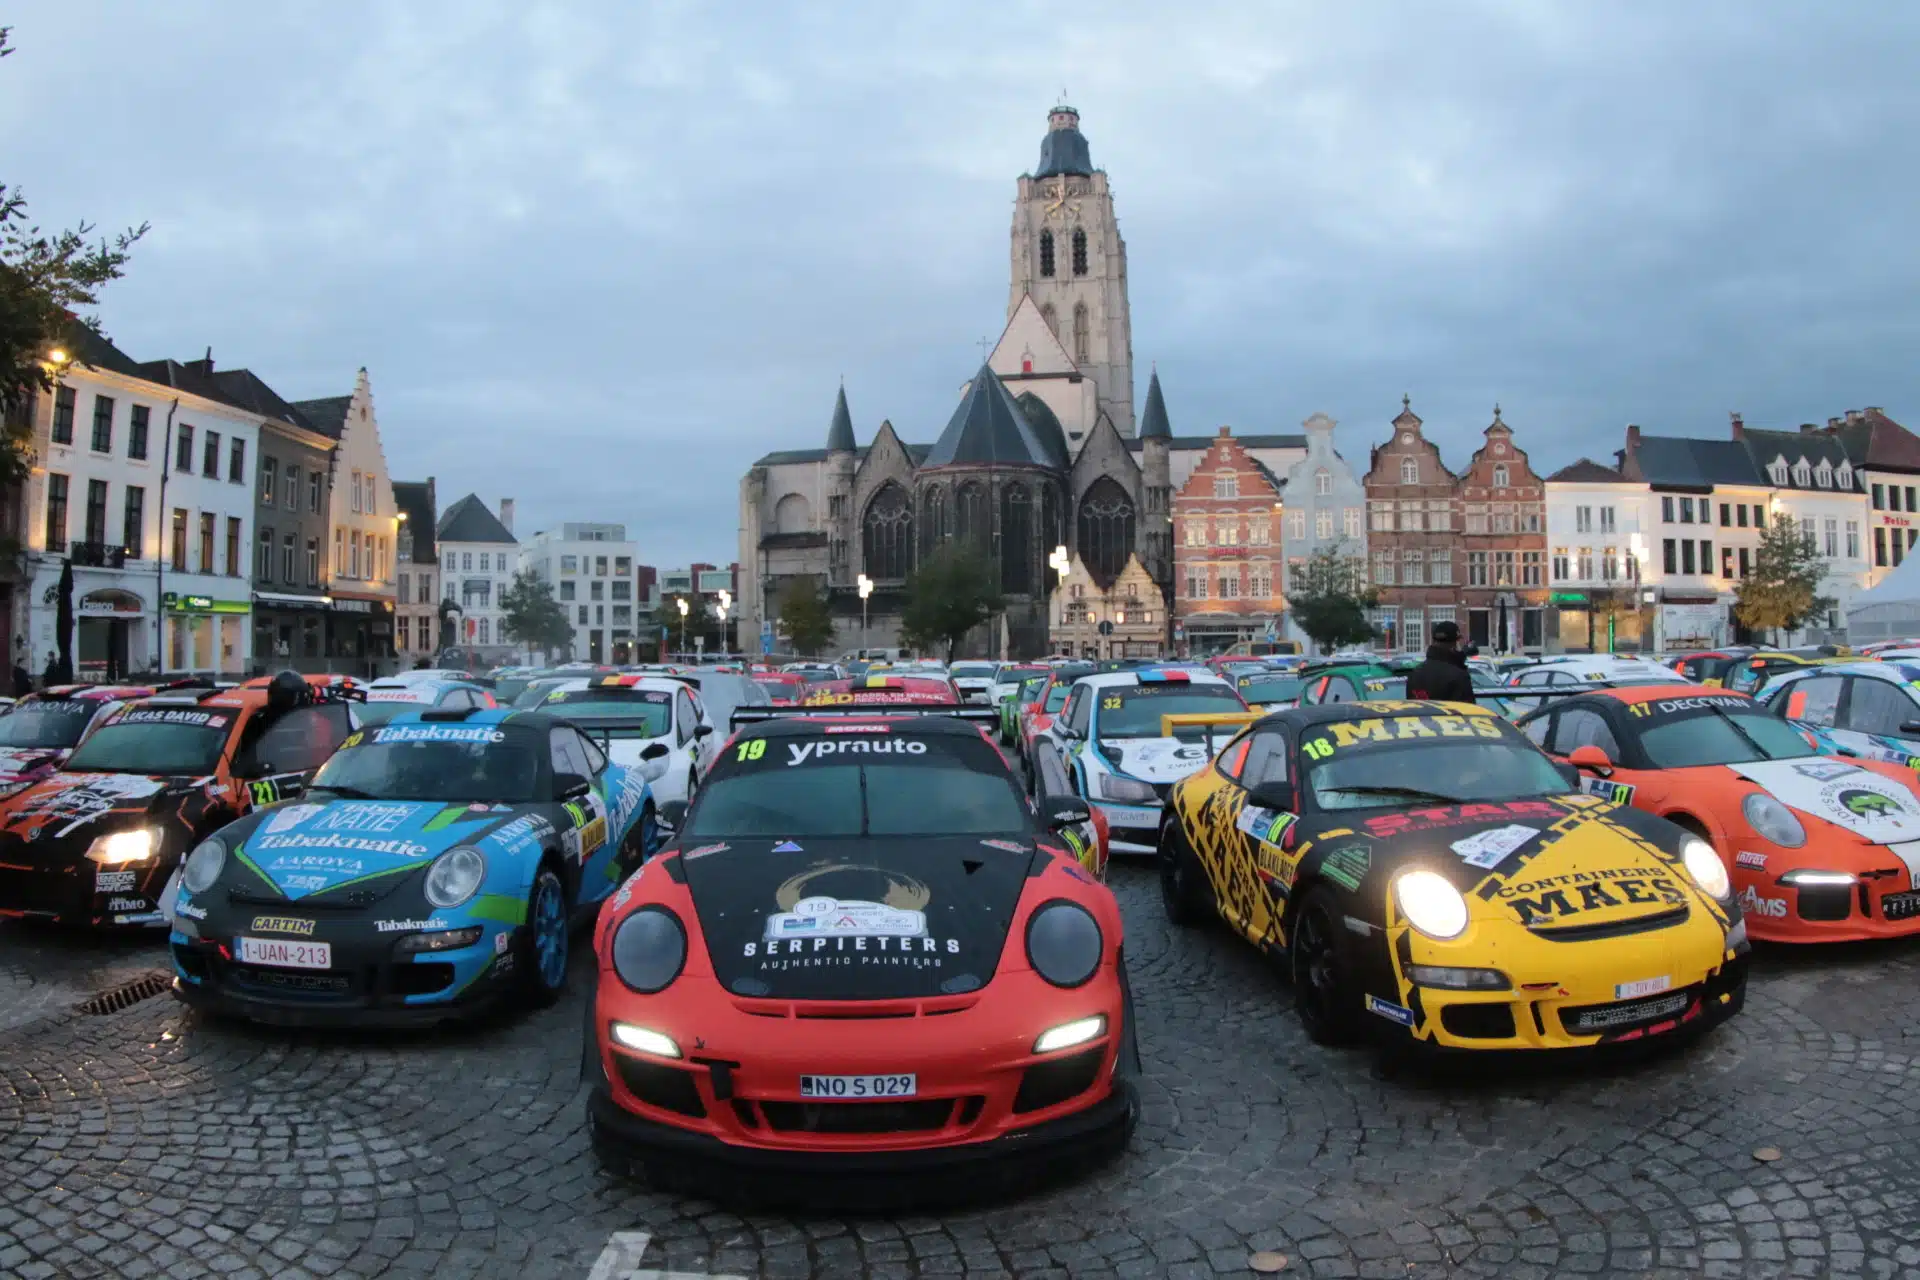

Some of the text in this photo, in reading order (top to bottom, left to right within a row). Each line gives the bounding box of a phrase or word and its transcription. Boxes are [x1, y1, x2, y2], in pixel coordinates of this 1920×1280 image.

[1103, 697, 1123, 710] 32
[1629, 702, 1652, 719] 17
[121, 710, 210, 723] LUCAS DAVID
[371, 726, 505, 744] Tabaknatie
[1328, 715, 1502, 748] MAES
[736, 738, 768, 762] 19
[787, 737, 928, 767] yprauto
[1302, 737, 1335, 761] 18
[253, 782, 274, 804] 21
[257, 832, 428, 857] Tabaknatie
[1499, 866, 1667, 899] CONTAINERS
[807, 902, 827, 913] 19
[1505, 877, 1689, 926] MAES
[252, 917, 315, 935] CARTIM
[373, 917, 449, 933] Tabaknatie
[243, 942, 328, 966] 1-UAN-213
[743, 936, 961, 957] SERPIETERS
[761, 956, 942, 971] AUTHENTIC PAINTERS
[816, 1075, 912, 1095] NO S 029
